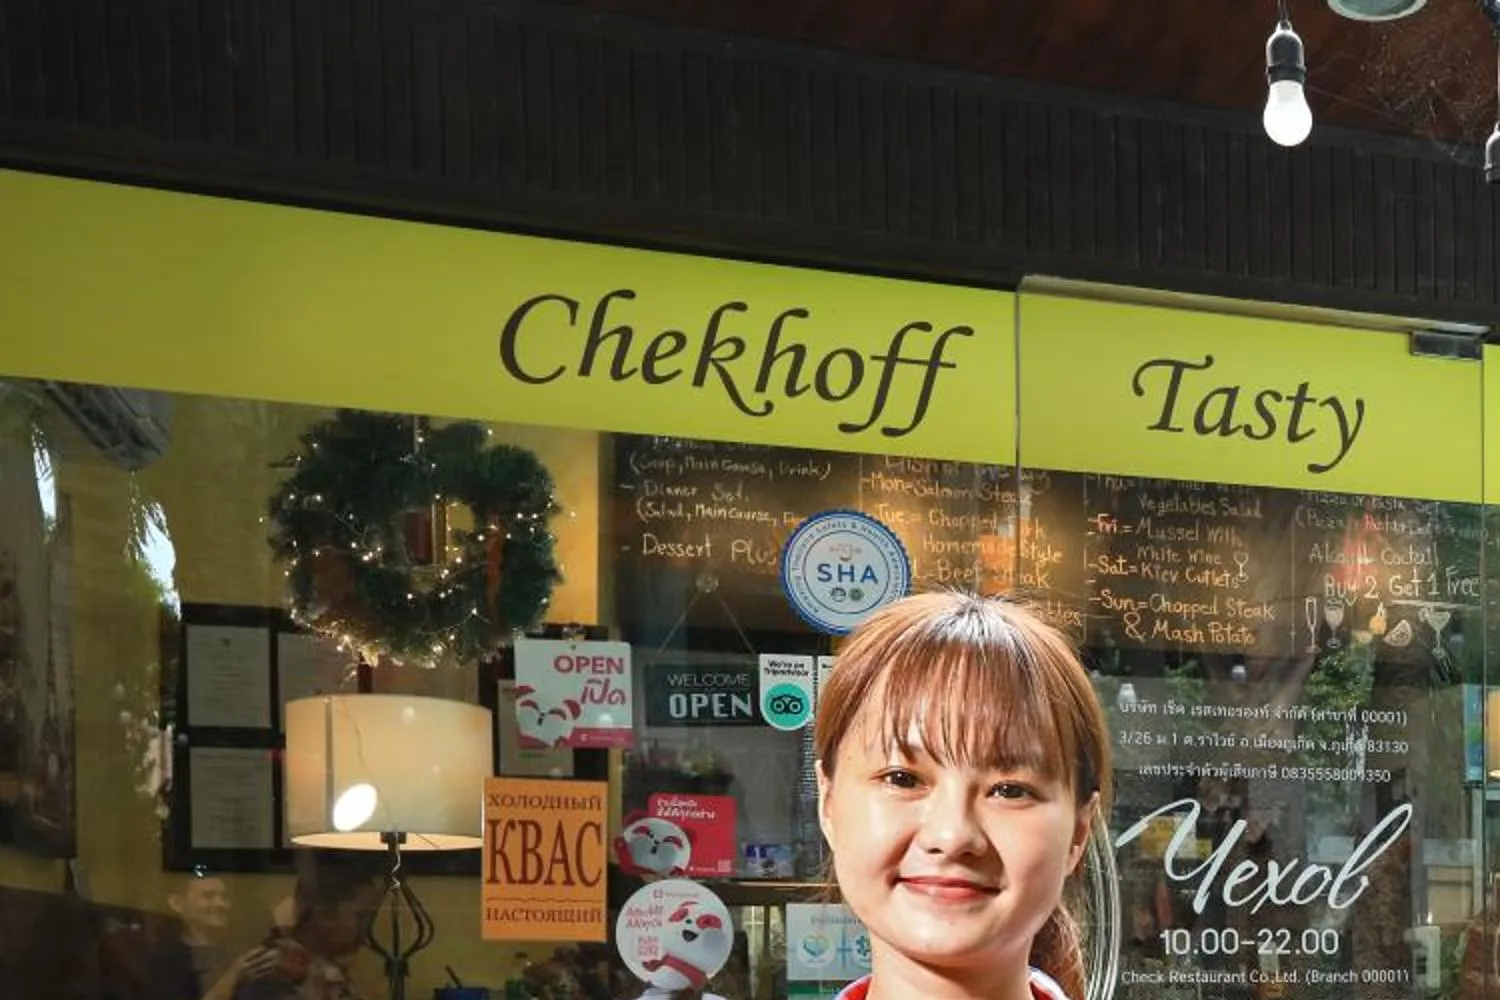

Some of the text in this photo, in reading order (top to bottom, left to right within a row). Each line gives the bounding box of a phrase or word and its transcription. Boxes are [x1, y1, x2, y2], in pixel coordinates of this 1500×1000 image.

[499, 289, 975, 438] Chekhoff
[1131, 354, 1366, 474] Tasty
[641, 532, 713, 559] Dessert
[817, 563, 878, 585] SHA
[1363, 575, 1381, 599] 2
[554, 655, 624, 675] OPEN
[581, 677, 627, 705] เปิด
[666, 673, 750, 688] WELCOME
[669, 692, 753, 719] OPEN
[1367, 739, 1409, 754] 83130
[487, 793, 602, 813] ХОЛОДНЫЙ
[485, 818, 603, 888] КВАС
[1115, 797, 1414, 915] Чехов
[486, 907, 602, 923] НАСТОЯЩИЙ
[1121, 971, 1165, 984] Check
[1168, 969, 1247, 984] Restaurant
[1304, 968, 1359, 986] (Branch
